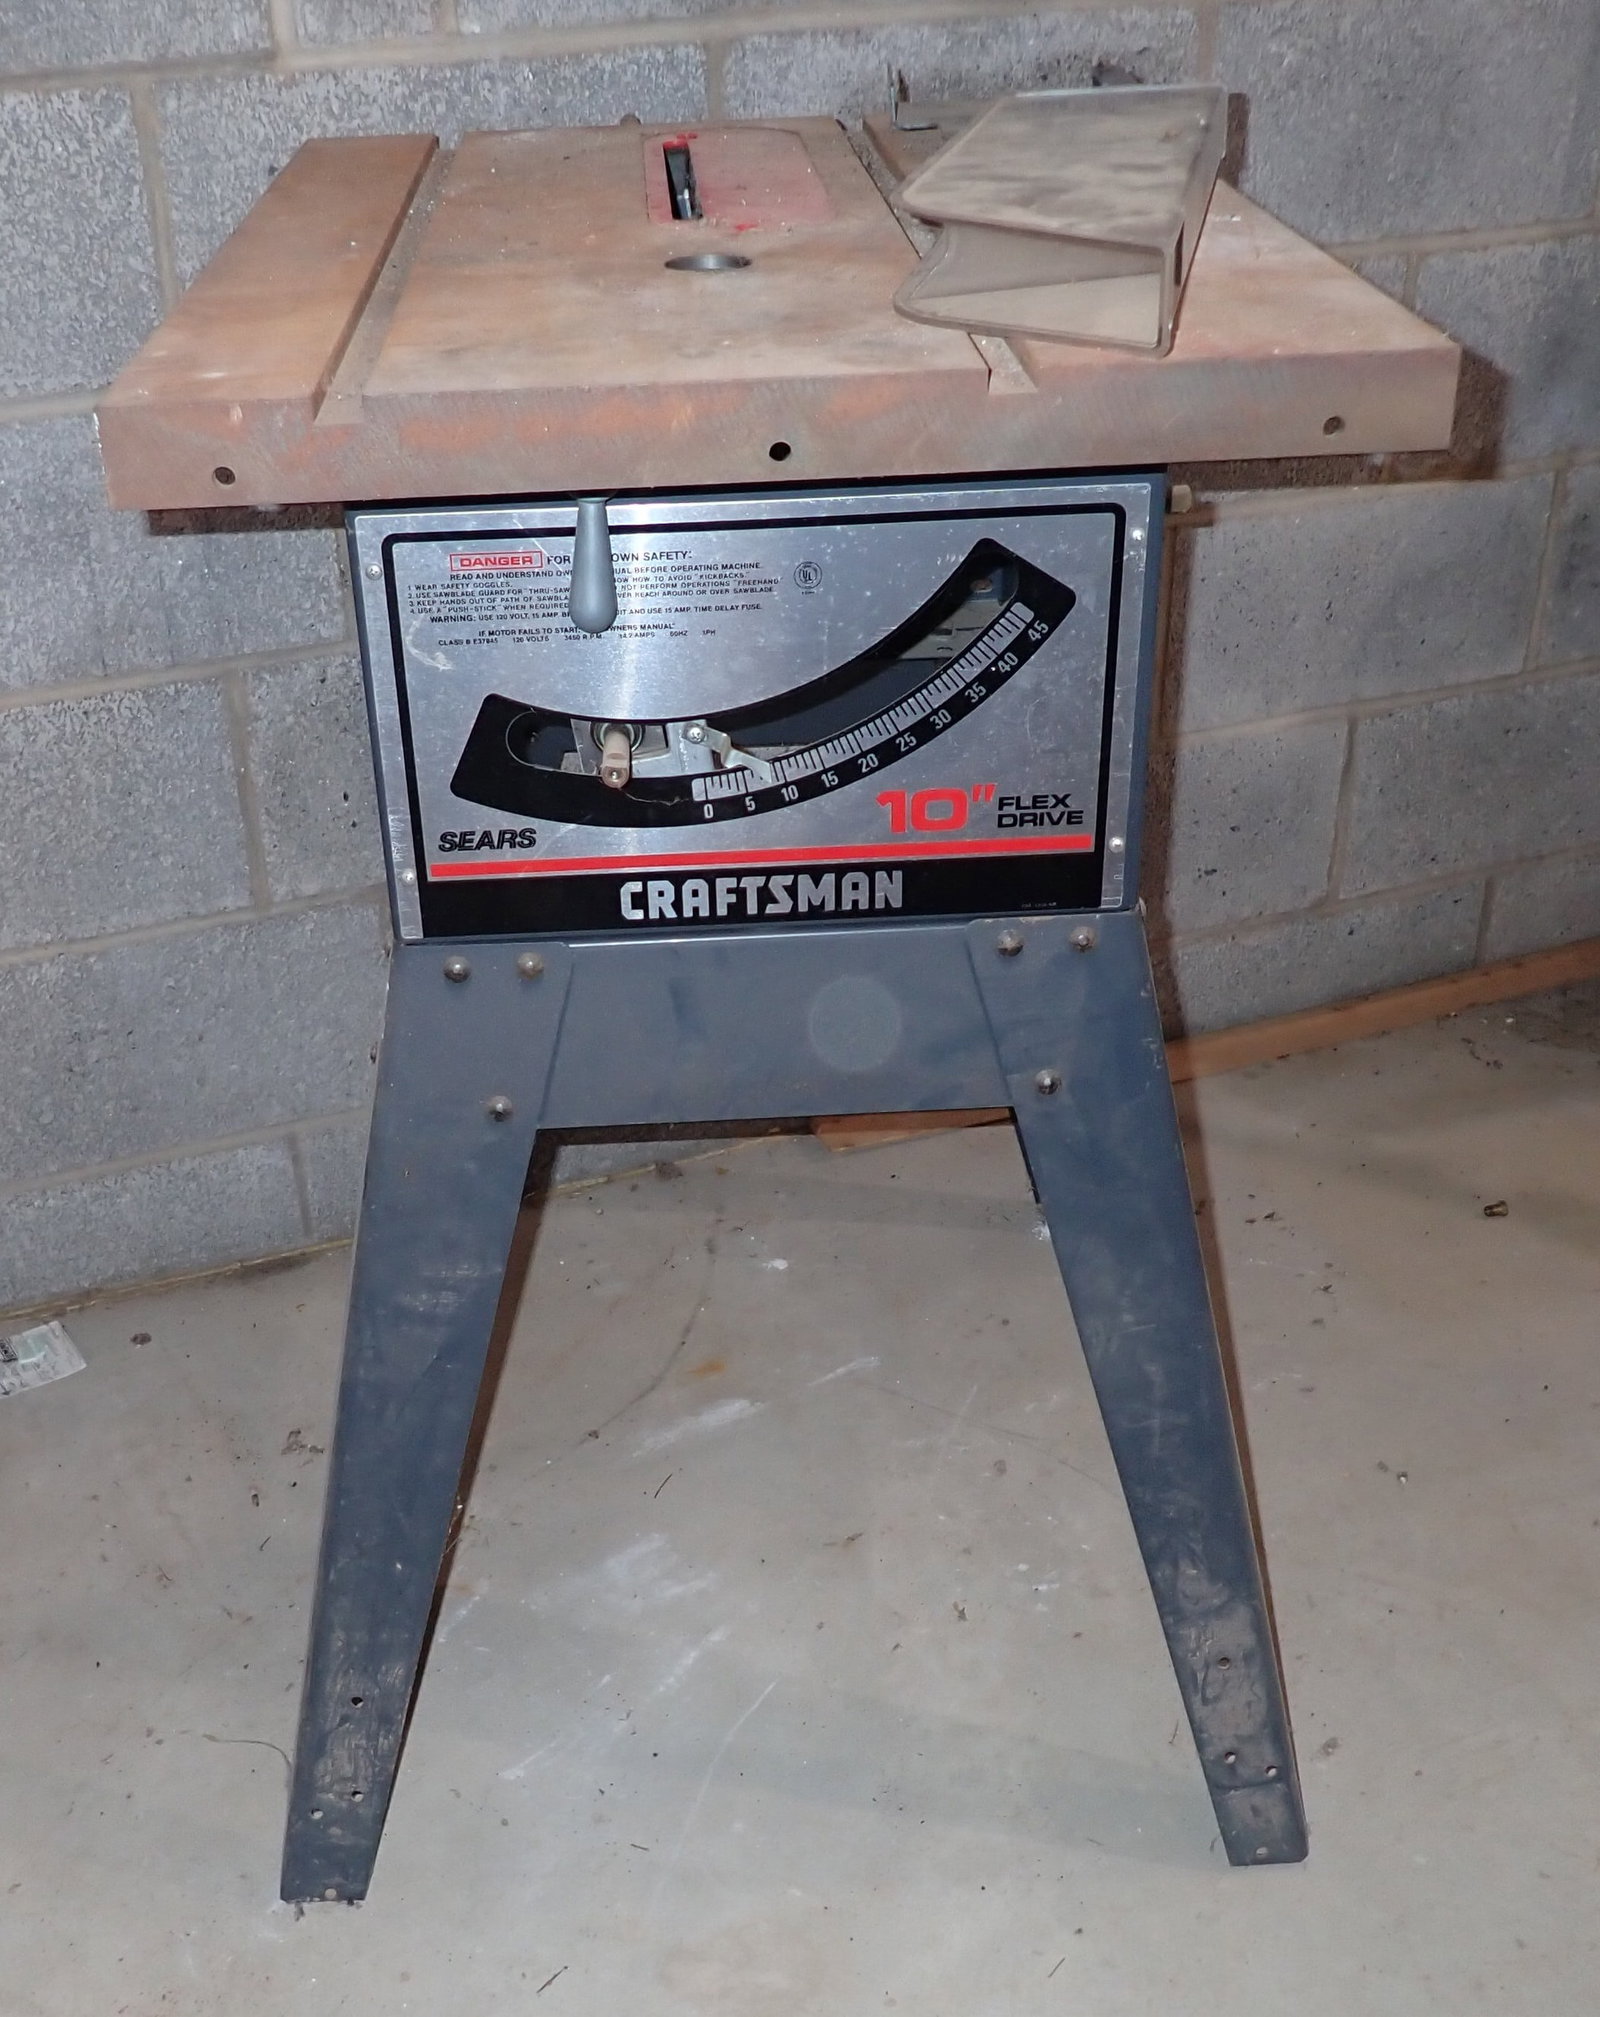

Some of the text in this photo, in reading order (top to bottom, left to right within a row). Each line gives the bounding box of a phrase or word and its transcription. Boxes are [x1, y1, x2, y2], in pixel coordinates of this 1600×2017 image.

[460, 556, 533, 567] DANGER
[547, 555, 571, 565] FOR
[611, 553, 639, 562] OWN
[450, 573, 473, 581] READ
[475, 572, 494, 580] AND
[496, 570, 554, 579] UNDERSTAND
[634, 565, 668, 573] BEFORE
[670, 563, 719, 572] OPERATING
[440, 582, 470, 590] SAFETY
[473, 581, 513, 589] GOGGLES.
[640, 582, 677, 590] PERFORM
[433, 590, 476, 598] SAWBLADE
[478, 589, 505, 597] GUARD
[662, 589, 694, 597] AROUND
[440, 598, 466, 606] HANDS
[429, 614, 476, 623] WARNING:
[478, 613, 494, 621] USE
[488, 629, 517, 637] MOTOR
[609, 624, 638, 632] WNERS
[438, 638, 464, 646] CLASS
[526, 635, 550, 643] VOLTS
[634, 631, 655, 639] AMPS
[703, 619, 1049, 819] 0 5 10 15 20 25 30 35 40 45
[876, 783, 997, 834] 10"
[997, 793, 1072, 811] FLEX
[997, 810, 1084, 828] DRIVE
[438, 827, 537, 852] SEARS
[620, 870, 903, 920] CRAFTSMAN
